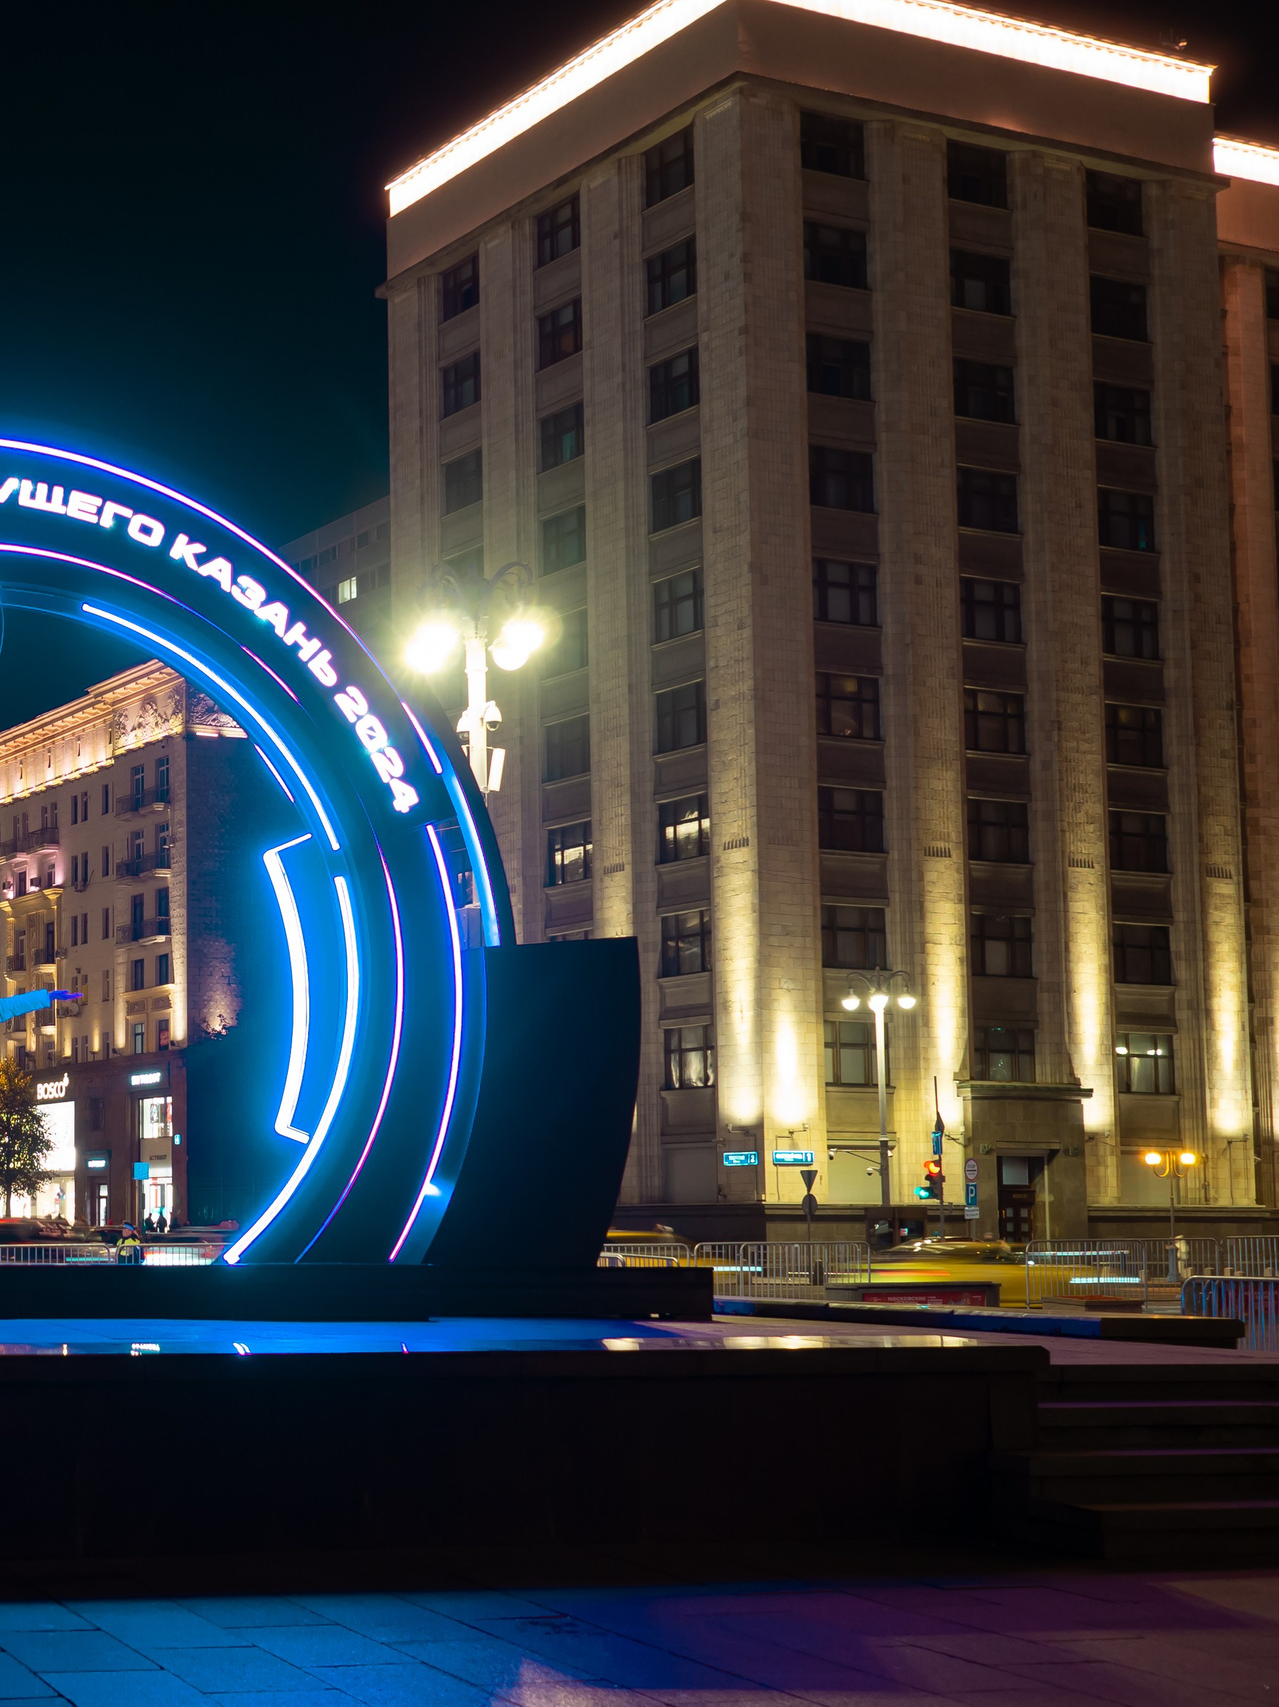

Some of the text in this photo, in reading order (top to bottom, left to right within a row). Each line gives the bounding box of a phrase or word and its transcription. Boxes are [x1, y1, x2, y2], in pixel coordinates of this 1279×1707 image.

[169, 532, 339, 688] КАЗАНЬ
[333, 684, 420, 814] 2024
[36, 1080, 67, 1100] BOSCO
